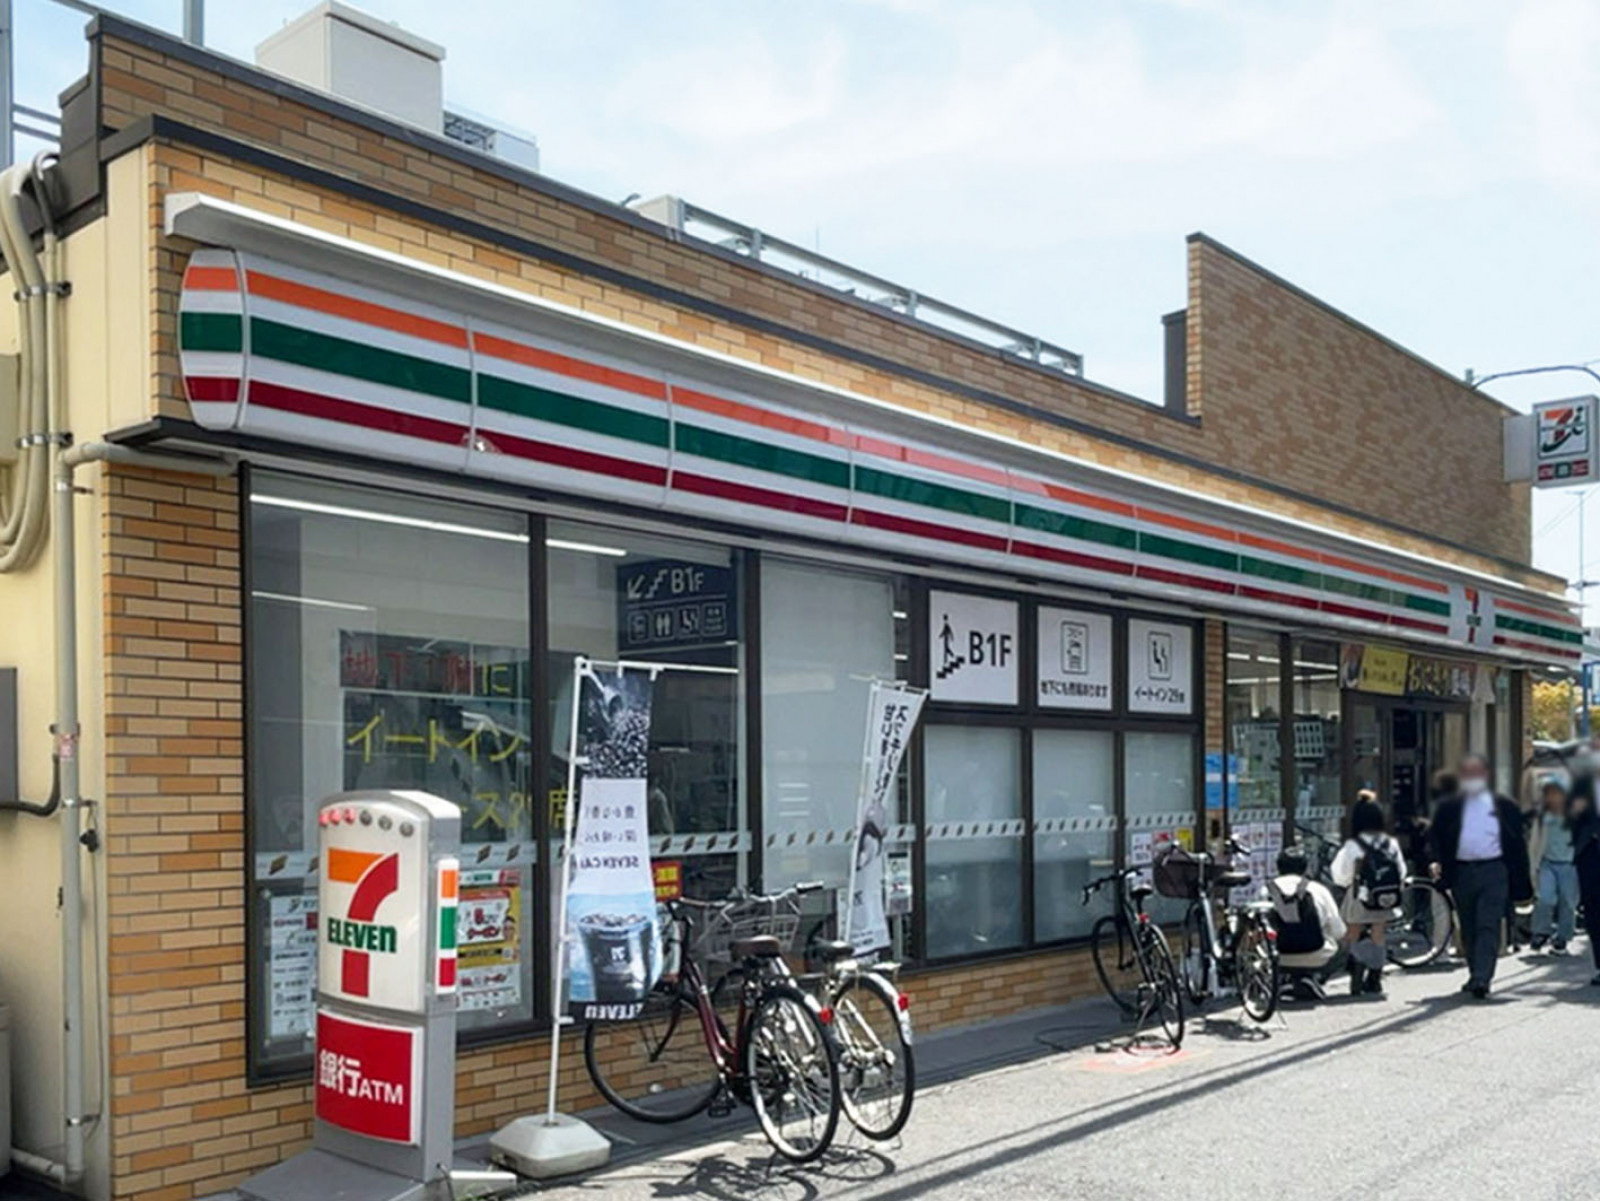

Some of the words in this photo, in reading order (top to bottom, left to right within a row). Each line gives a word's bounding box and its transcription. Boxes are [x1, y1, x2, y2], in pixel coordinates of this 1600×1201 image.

[671, 566, 704, 594] B1F
[968, 631, 1012, 668] B1F
[346, 713, 523, 764] イートイン
